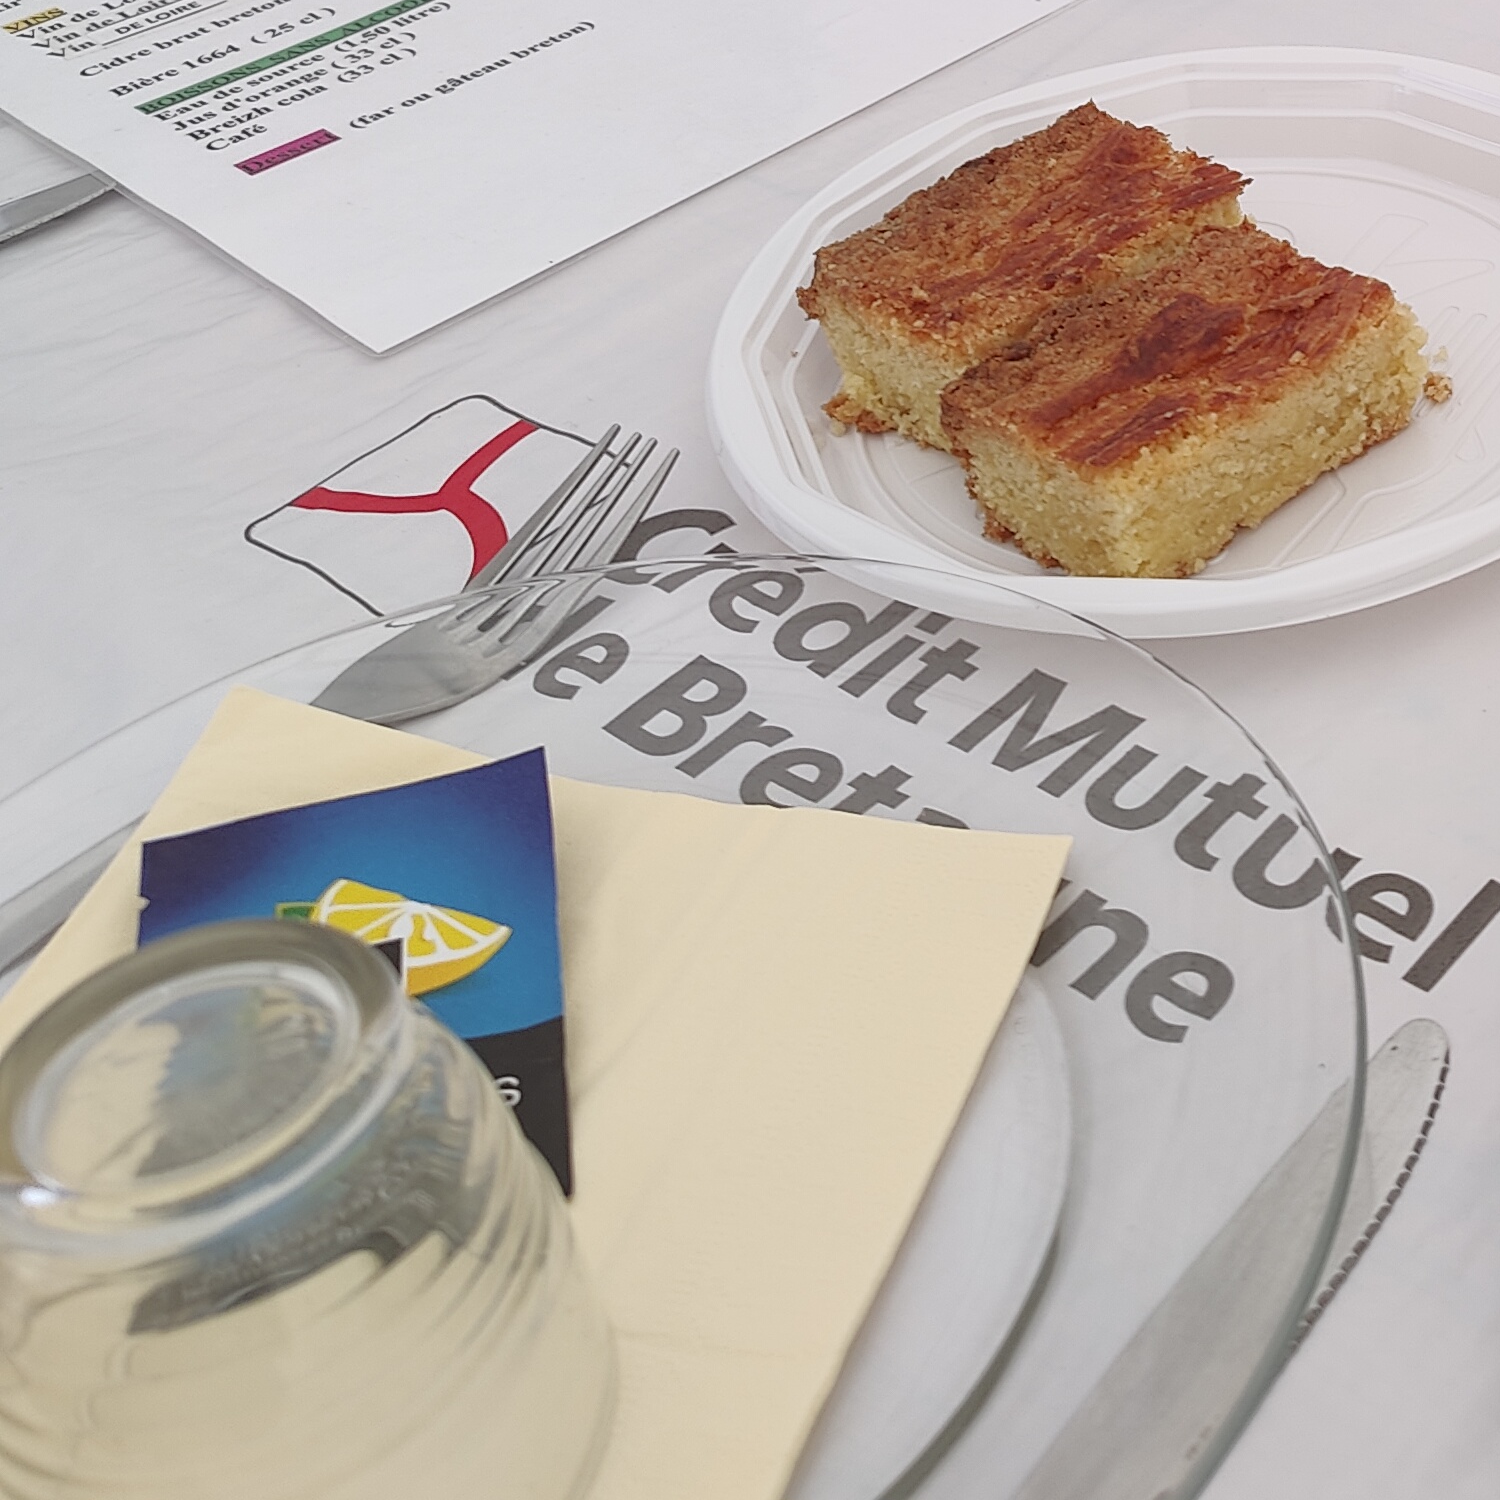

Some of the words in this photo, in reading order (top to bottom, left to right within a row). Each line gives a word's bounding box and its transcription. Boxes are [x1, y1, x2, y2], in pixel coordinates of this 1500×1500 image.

[2, 6, 66, 34] VINS
[16, 22, 66, 39] Vin
[70, 8, 100, 23] de
[31, 32, 82, 49] Vin
[86, 18, 115, 33] de
[46, 41, 97, 57] Vin
[114, 22, 144, 36] DE
[149, 0, 202, 25] LOIRE
[80, 47, 152, 78] Cidre
[152, 26, 211, 51] brut
[109, 66, 180, 98] Bière
[183, 43, 241, 71] 1664
[141, 61, 262, 115] BOISSONS
[268, 34, 332, 64] SANS
[154, 99, 209, 121] Eau
[213, 84, 244, 100] de
[246, 53, 326, 87] source
[334, 25, 391, 53] (1,50
[391, 1, 452, 28] litre)
[174, 110, 218, 132] Jus
[221, 67, 329, 113] d'orange
[186, 103, 275, 142] Breizh
[277, 84, 329, 107] cola
[337, 64, 376, 84] (33
[240, 130, 341, 174] Dessert
[349, 104, 396, 130] (far
[400, 91, 434, 109] ou
[434, 57, 512, 95] gâteau
[510, 20, 596, 61] breton)
[205, 123, 269, 151] Café
[604, 508, 981, 726] Crédit
[603, 654, 1235, 1044] Bretne
